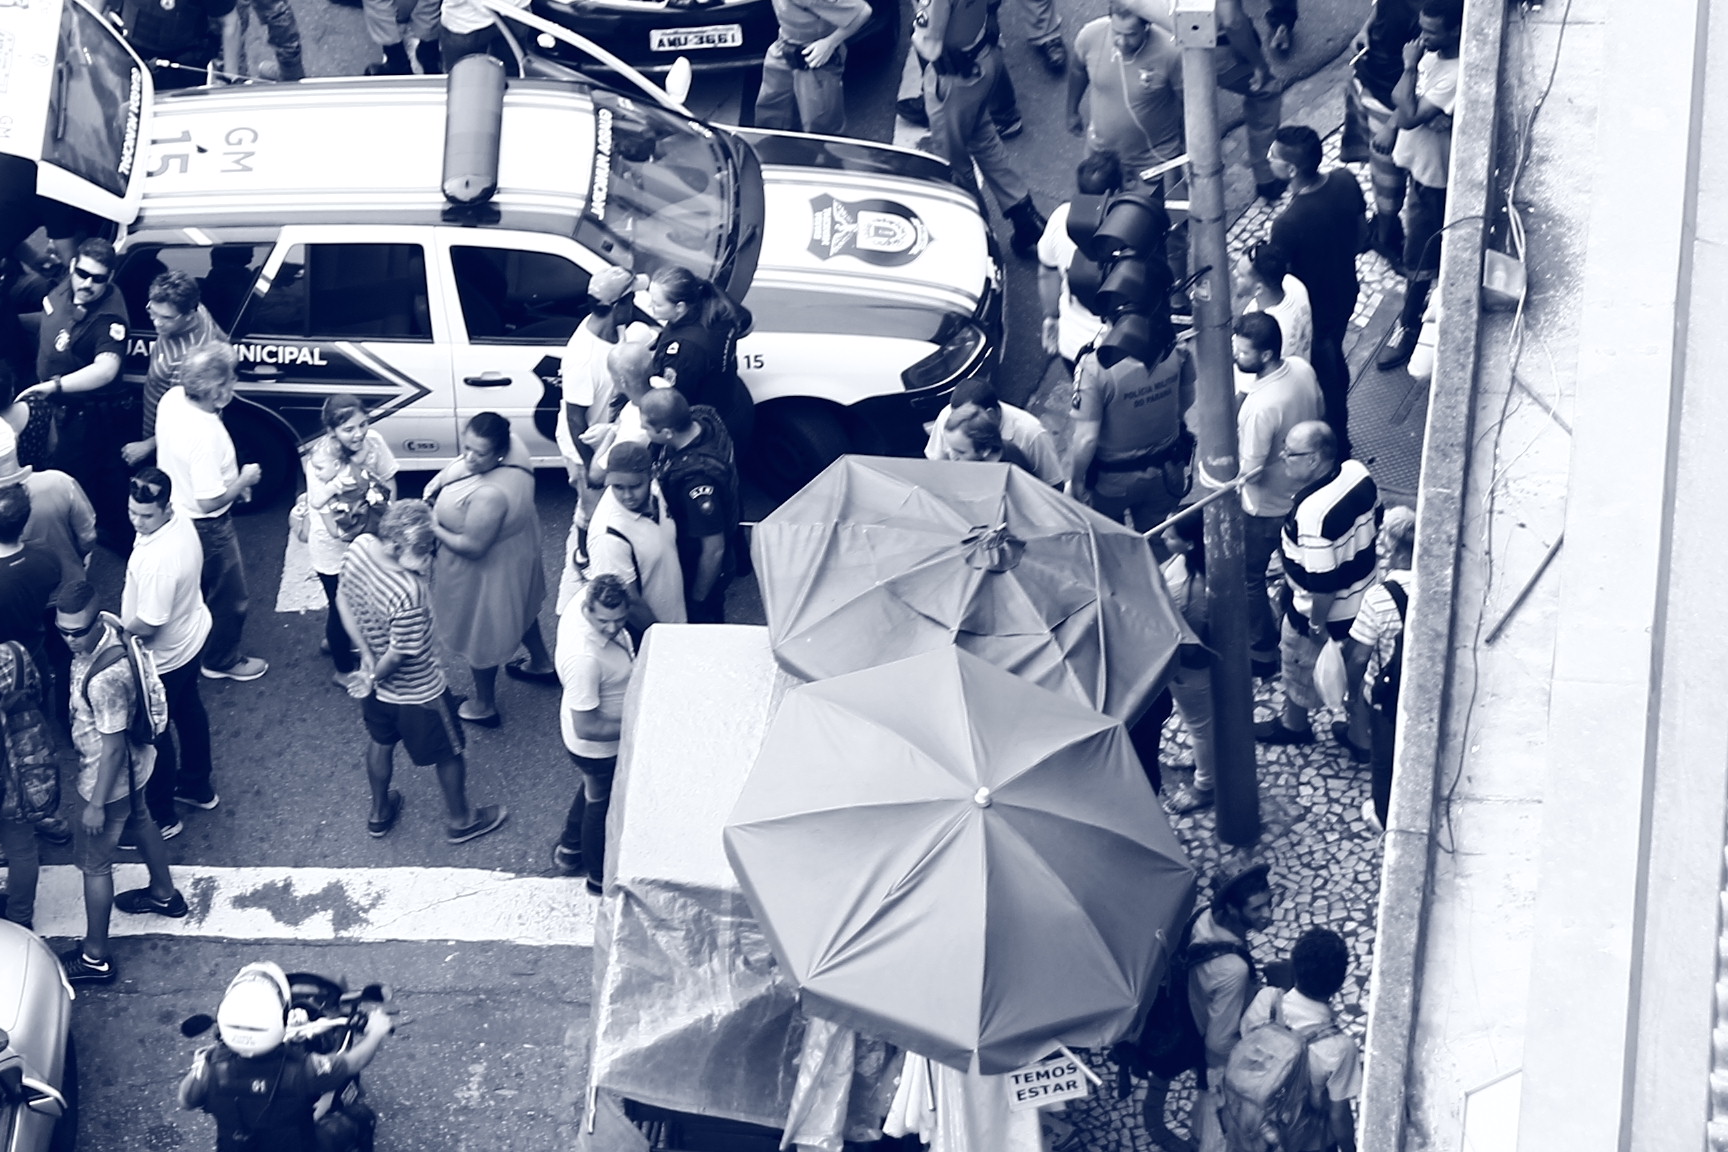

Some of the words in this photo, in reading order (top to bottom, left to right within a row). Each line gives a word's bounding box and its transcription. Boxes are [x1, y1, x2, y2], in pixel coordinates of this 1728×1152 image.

[146, 130, 192, 178] 15
[220, 127, 259, 173] GM
[233, 343, 328, 366] NICIPAL
[743, 354, 765, 370] 15
[1011, 1062, 1078, 1085] TEMOS
[1016, 1080, 1079, 1102] ESTAR
